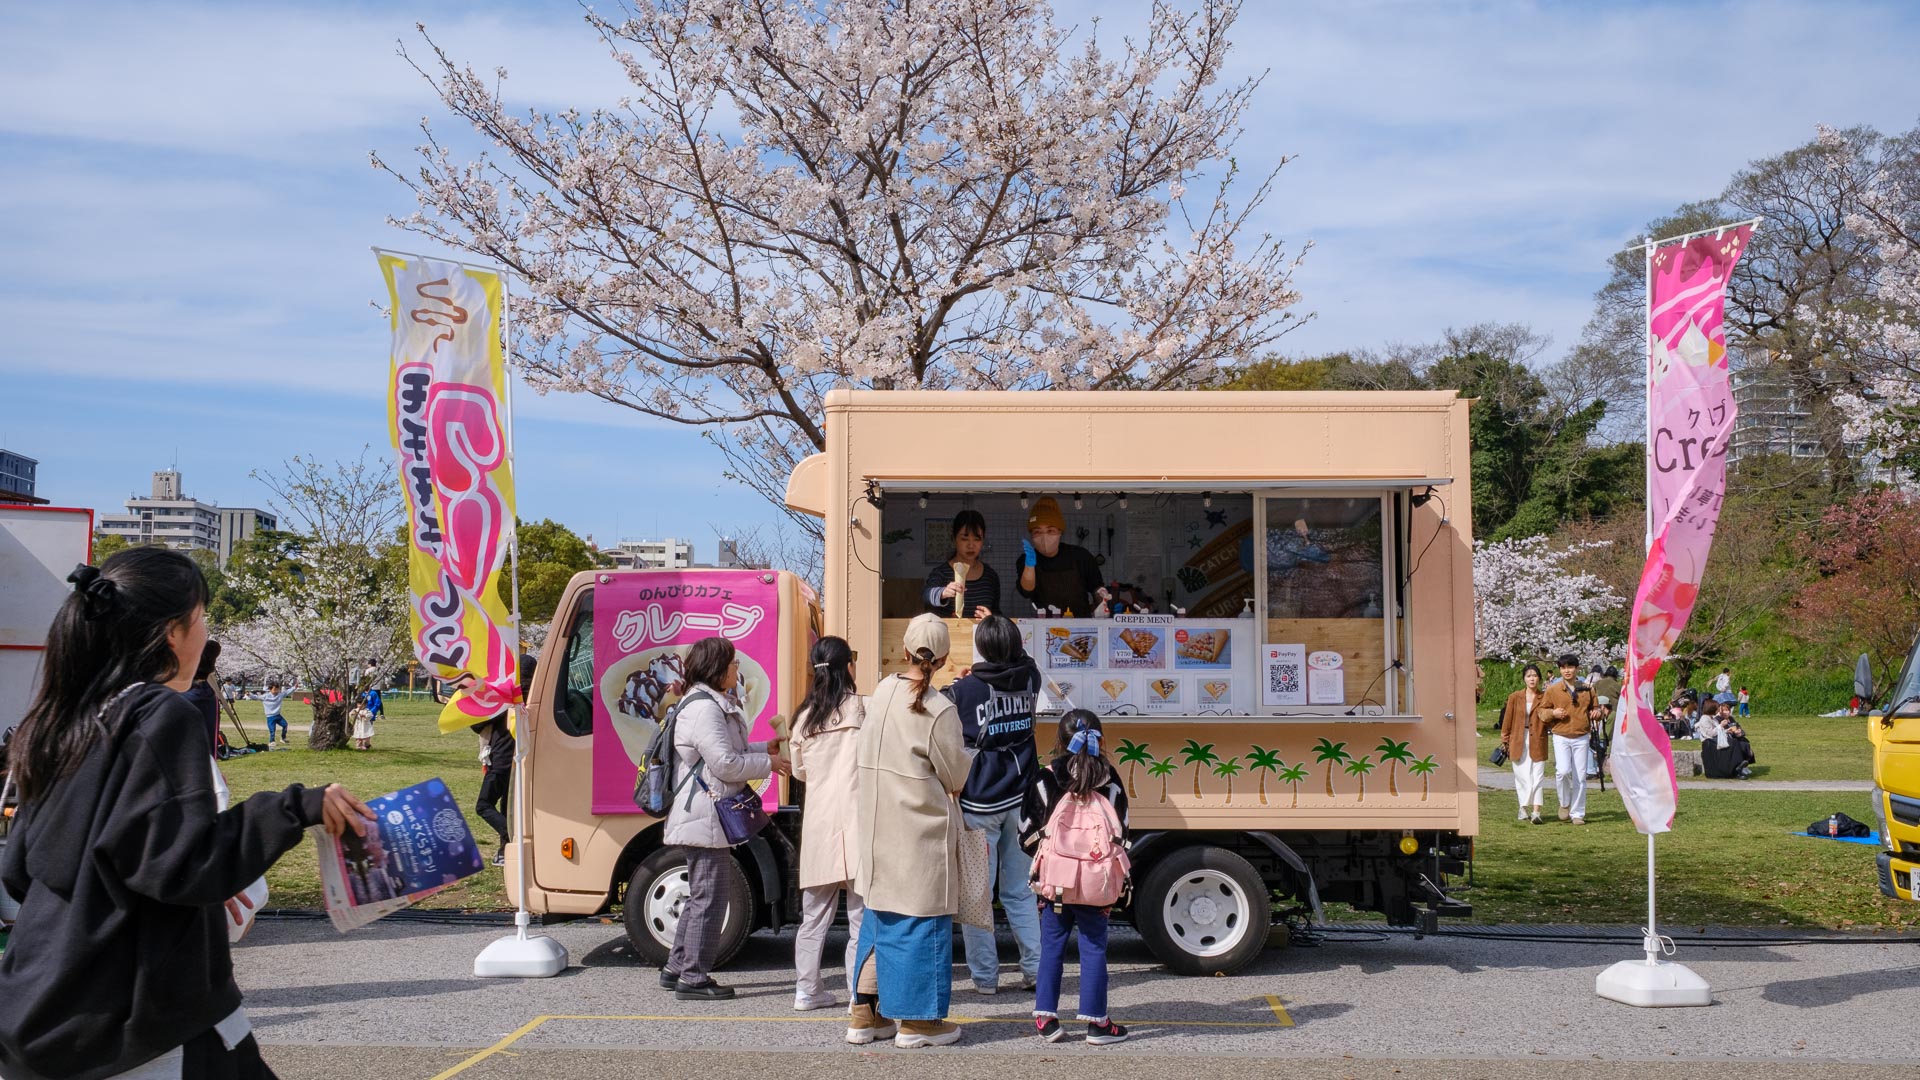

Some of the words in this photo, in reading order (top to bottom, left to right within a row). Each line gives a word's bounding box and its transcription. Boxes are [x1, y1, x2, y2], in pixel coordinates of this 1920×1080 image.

[1199, 544, 1238, 573] CATCH
[639, 584, 733, 601] のんびりカフェ
[613, 603, 764, 652] クレープ
[1115, 615, 1145, 623] CREPE
[1147, 616, 1173, 624] MENU
[975, 694, 1033, 726] COLUMB
[988, 717, 1032, 736] UNIVERSIT
